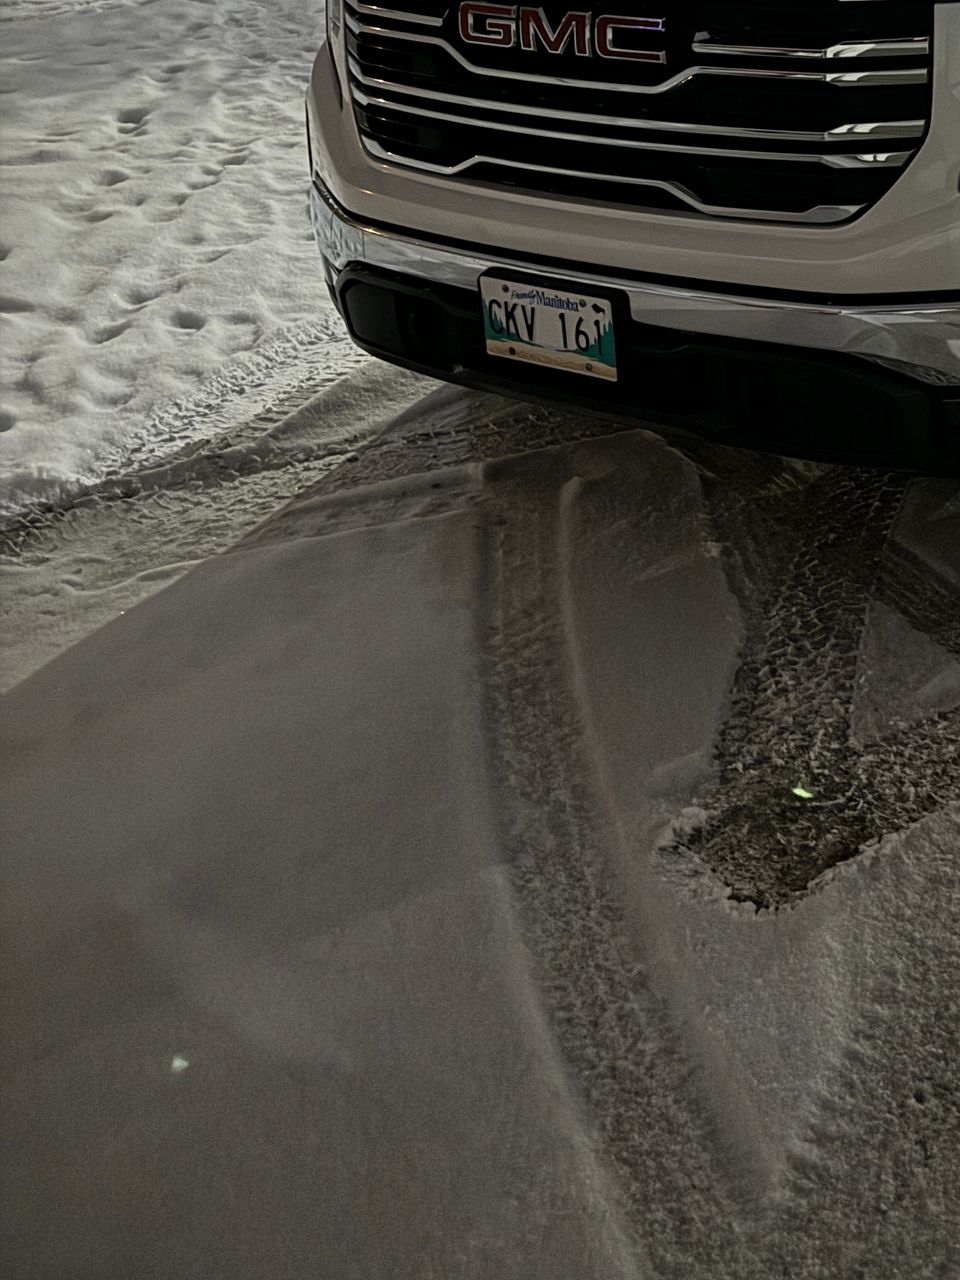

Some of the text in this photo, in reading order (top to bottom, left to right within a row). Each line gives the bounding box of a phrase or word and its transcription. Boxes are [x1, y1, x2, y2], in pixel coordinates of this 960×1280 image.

[458, 0, 667, 64] GMC
[488, 299, 602, 356] CKV 161
[535, 290, 580, 313] Manitoba
